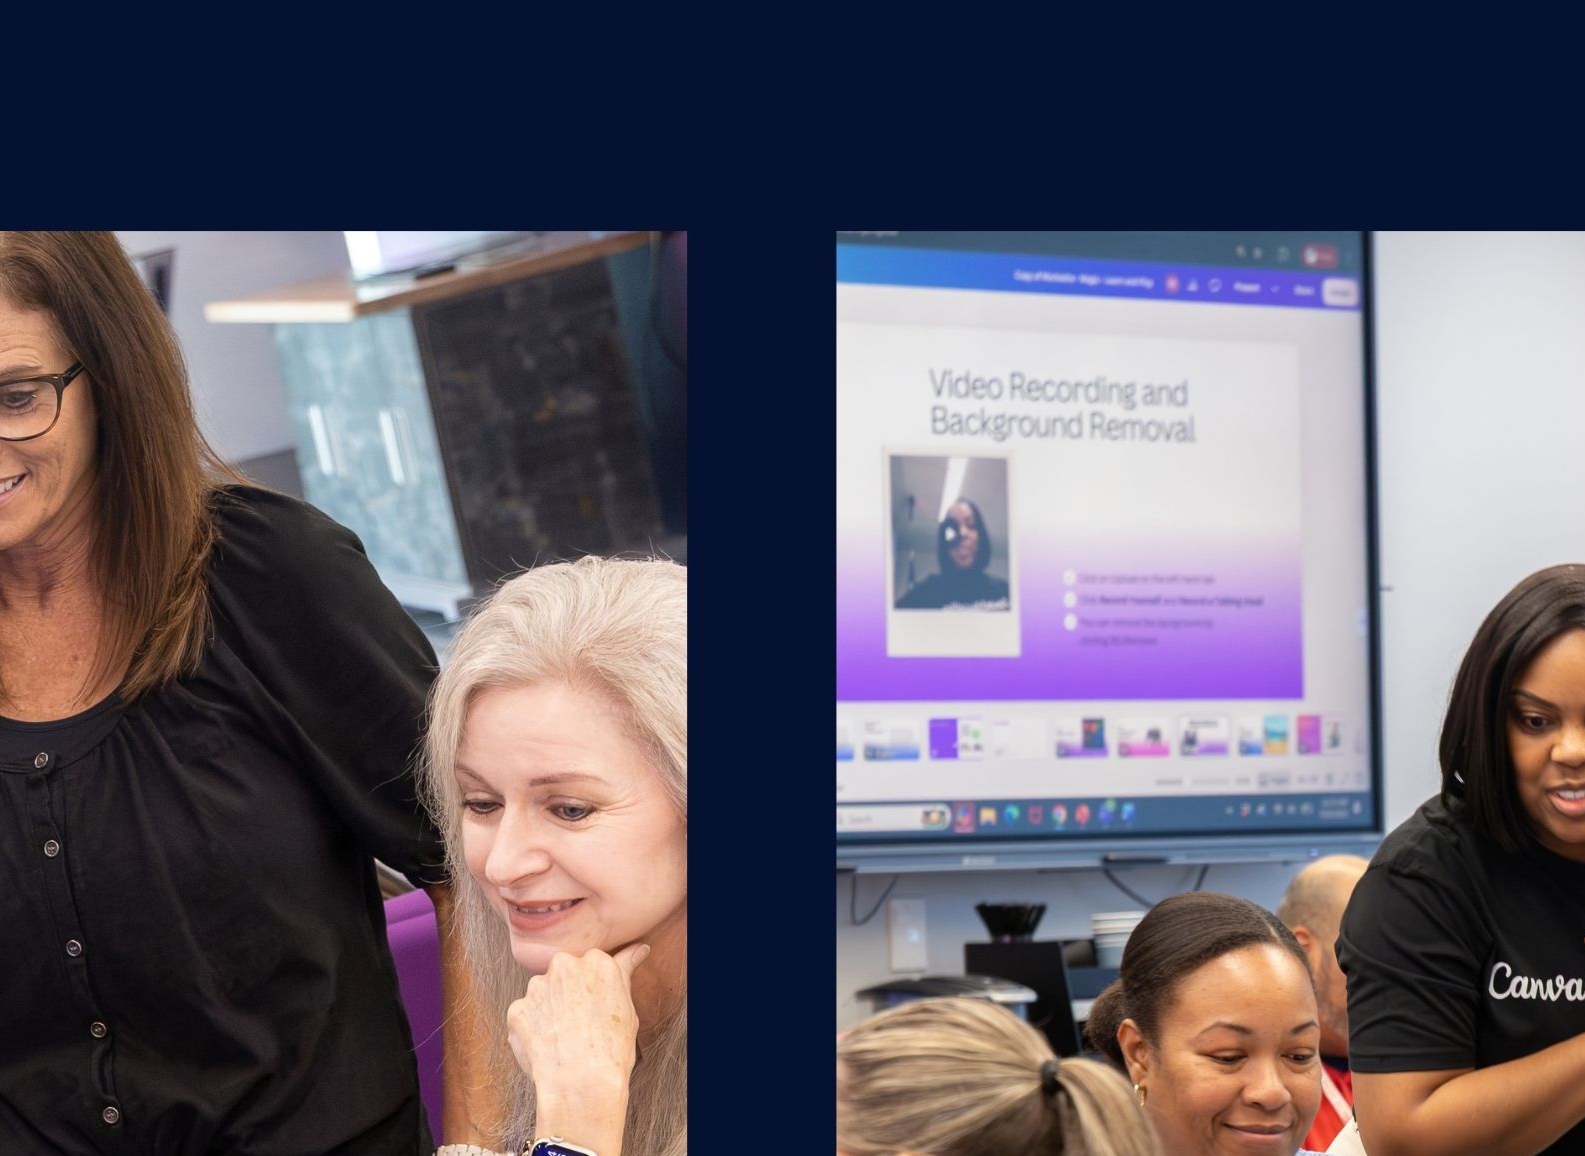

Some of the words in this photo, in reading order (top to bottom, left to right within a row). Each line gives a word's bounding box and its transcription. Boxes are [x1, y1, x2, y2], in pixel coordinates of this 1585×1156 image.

[929, 368, 1004, 400] Video
[1009, 371, 1137, 410] Recording
[1142, 380, 1189, 407] and
[931, 406, 1083, 442] Background
[1090, 410, 1196, 443] Removal
